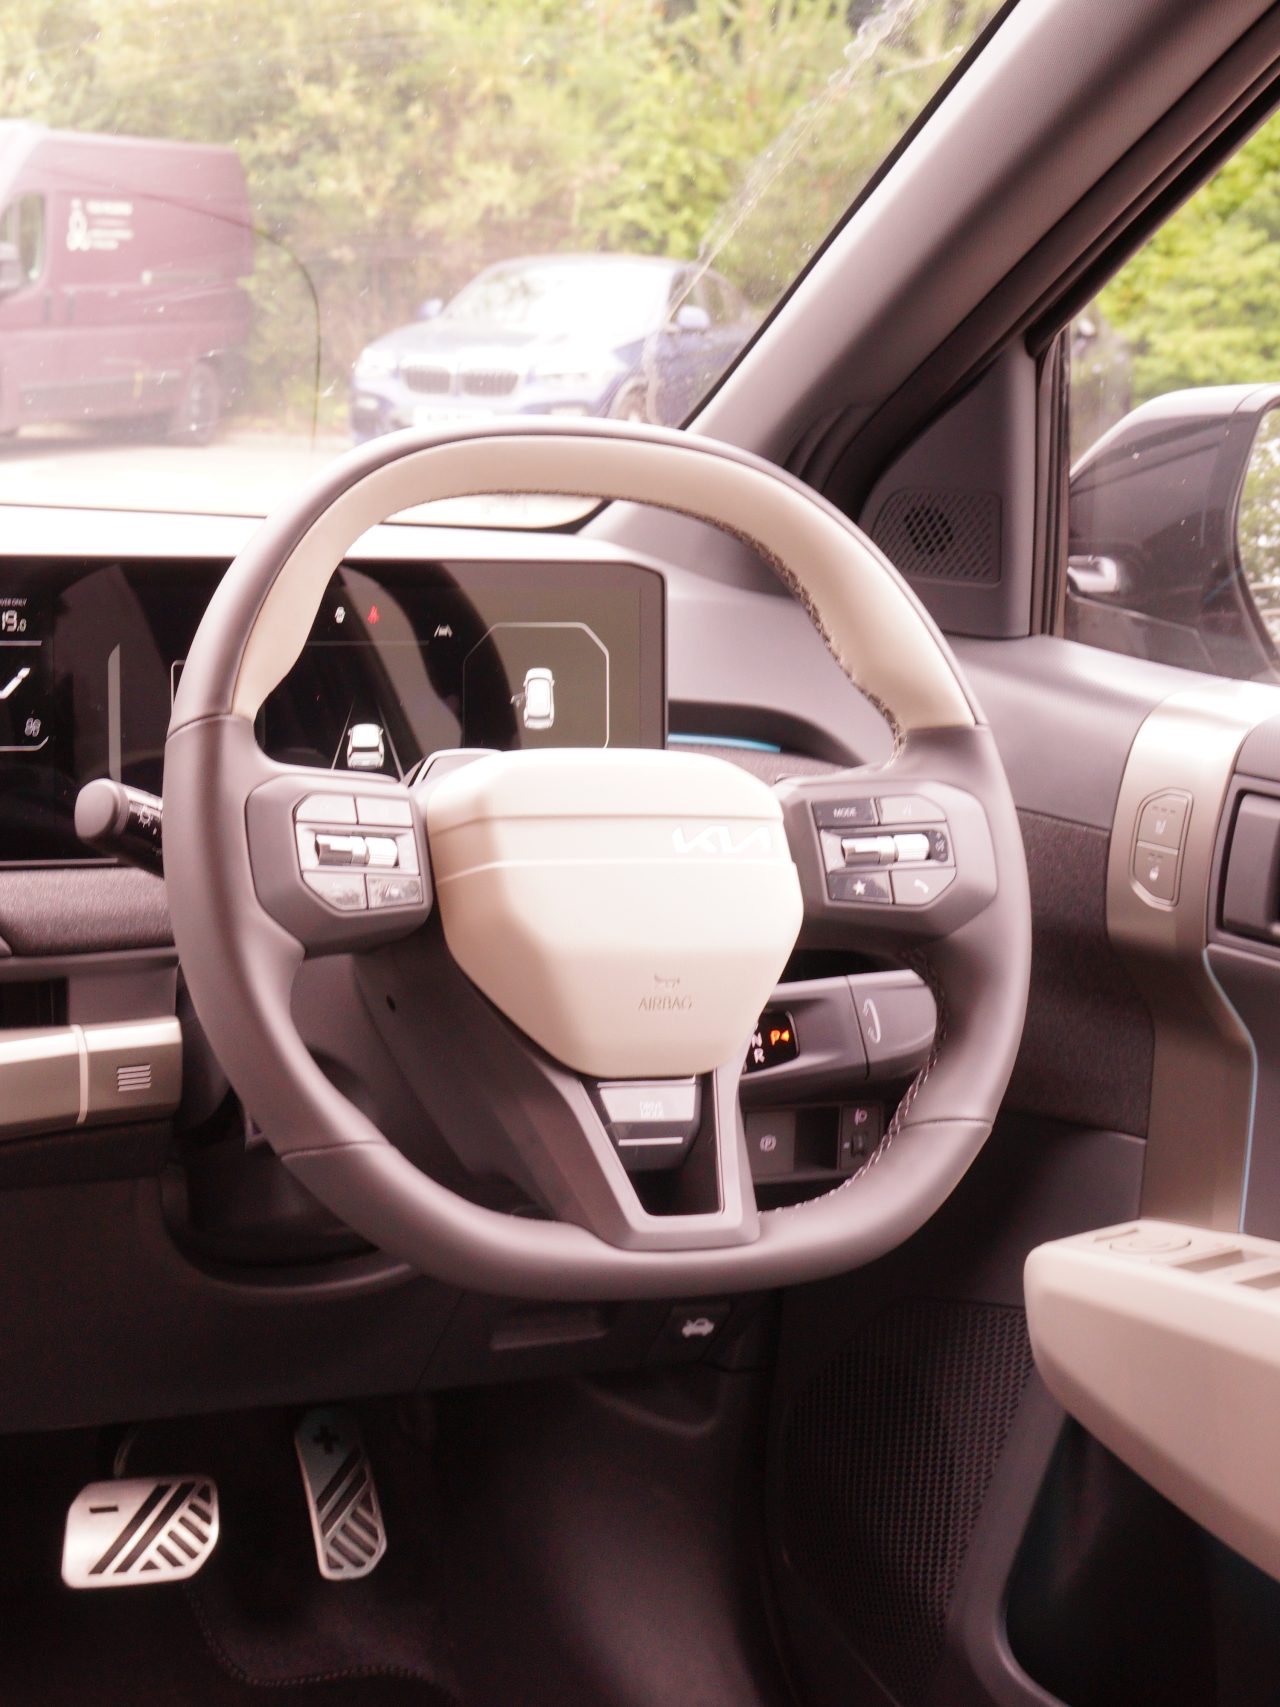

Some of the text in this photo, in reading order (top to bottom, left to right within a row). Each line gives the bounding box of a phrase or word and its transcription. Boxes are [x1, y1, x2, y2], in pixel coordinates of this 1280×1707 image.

[671, 824, 772, 854] KIA
[638, 996, 693, 1011] AIRBAG
[770, 1030, 781, 1046] P
[754, 1048, 765, 1064] R
